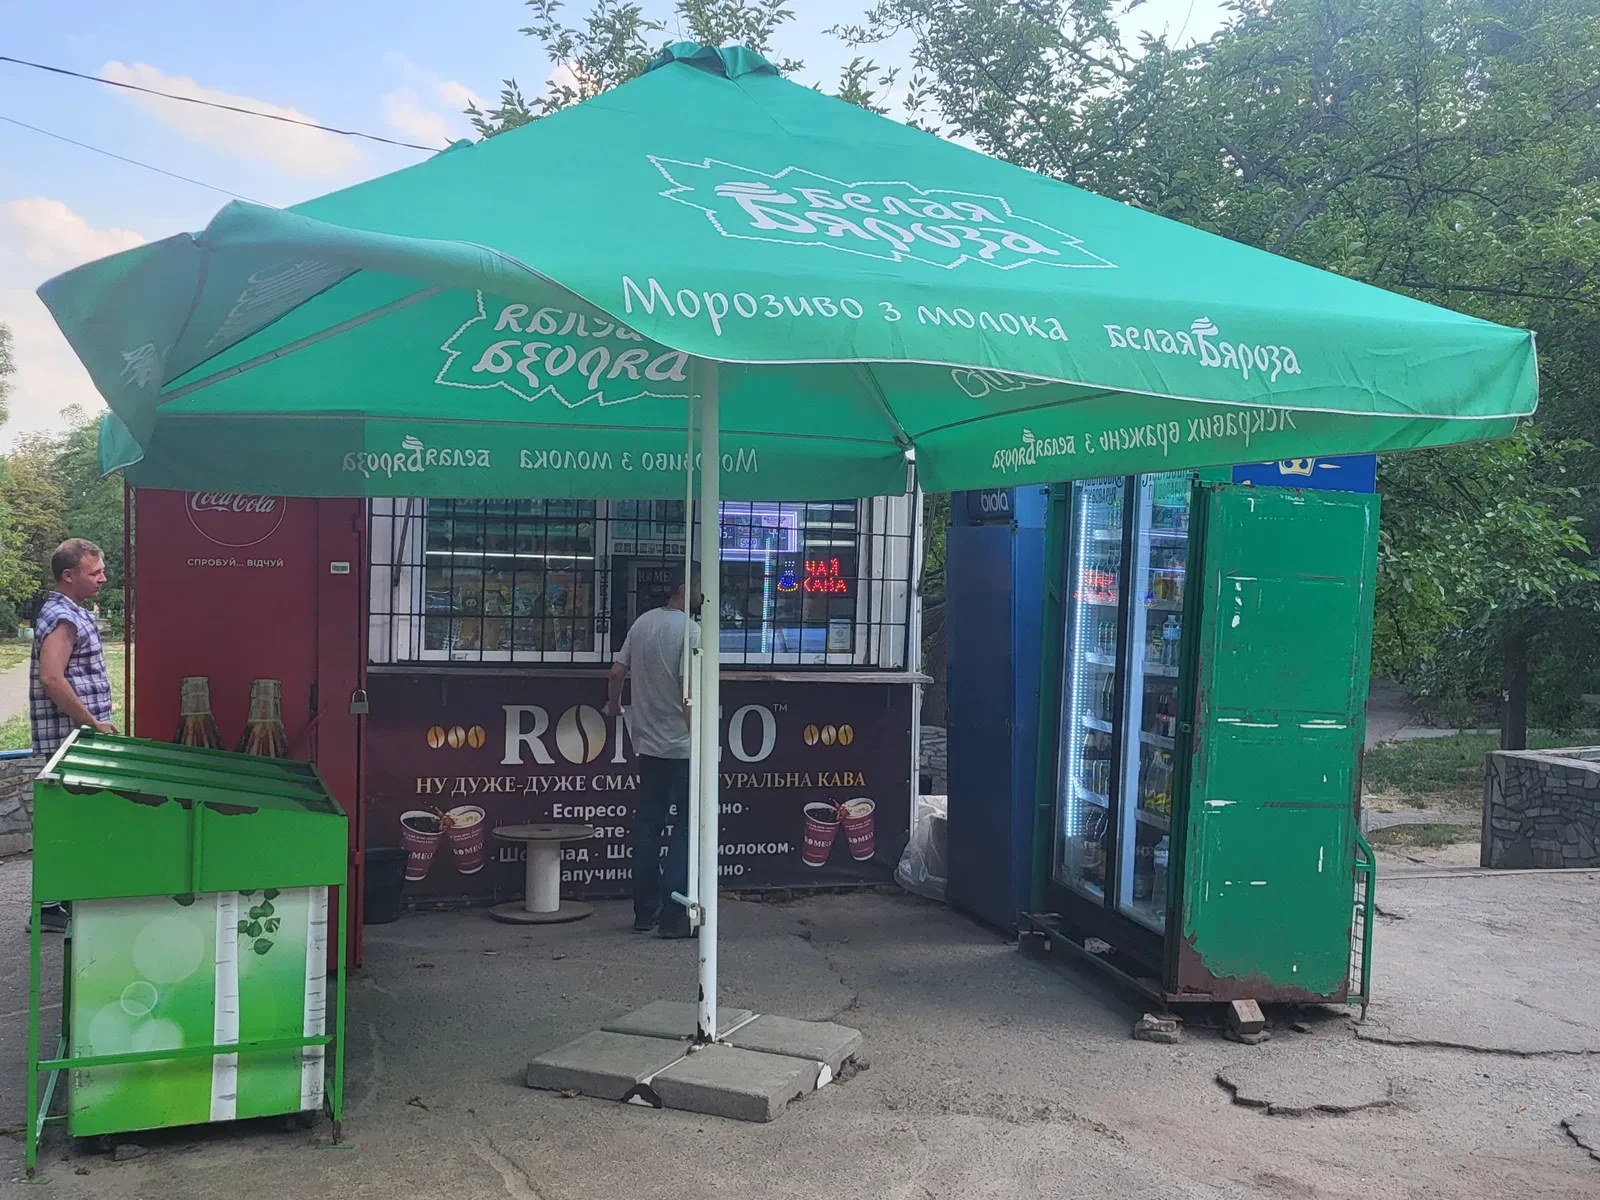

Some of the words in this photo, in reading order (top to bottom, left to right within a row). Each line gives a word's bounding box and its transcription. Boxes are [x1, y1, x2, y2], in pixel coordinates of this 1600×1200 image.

[621, 275, 864, 337] Морозиво
[917, 305, 1069, 342] молока
[247, 558, 284, 568] ВІДЧУЙ
[416, 777, 448, 794] НУ
[451, 775, 587, 797] ДУЖЕ-ДУЖЕ
[719, 772, 813, 789] УРАЛЬНА
[818, 771, 866, 787] КАВА
[553, 803, 627, 821] Еспресо
